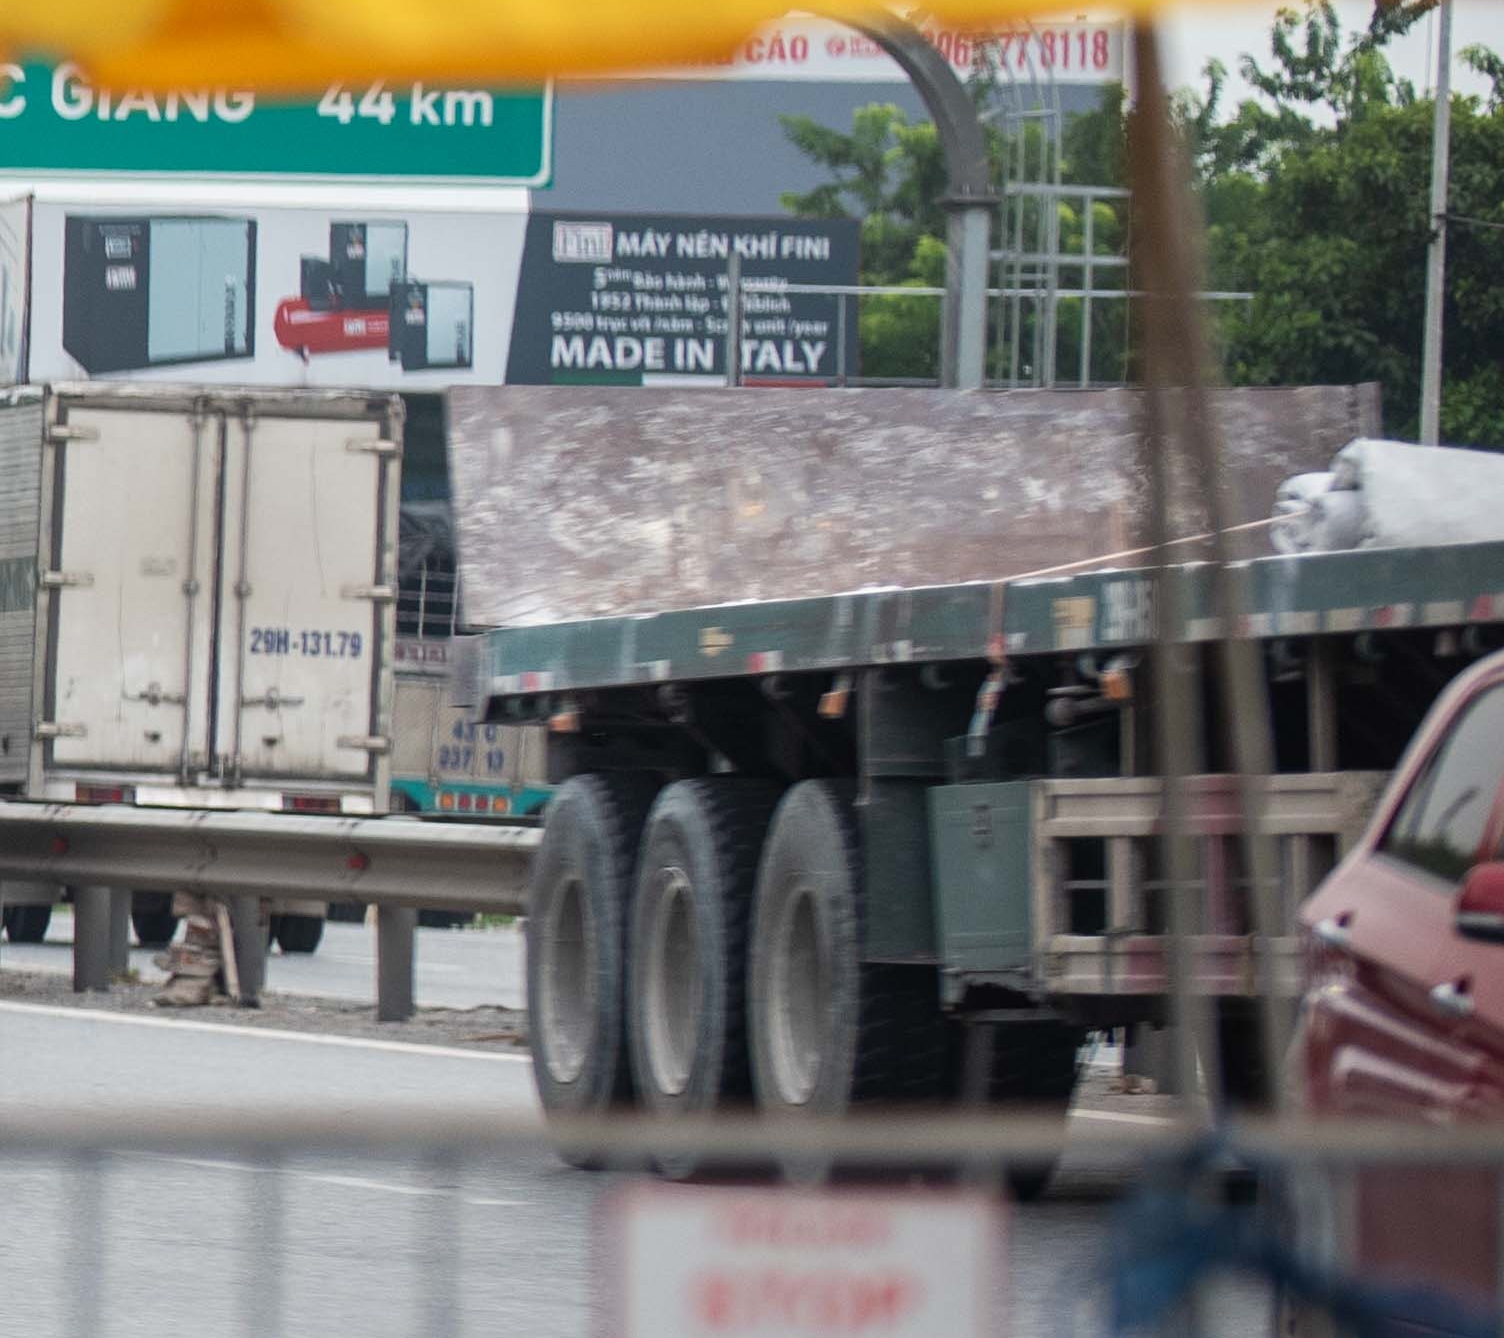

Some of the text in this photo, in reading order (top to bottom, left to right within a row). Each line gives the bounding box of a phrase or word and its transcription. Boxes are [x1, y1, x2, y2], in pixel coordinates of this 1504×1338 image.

[316, 77, 396, 126] 44
[410, 79, 494, 127] km
[780, 234, 831, 261] FINI
[550, 335, 827, 373] MADE IN TALY
[250, 626, 363, 658] 29H-131.79
